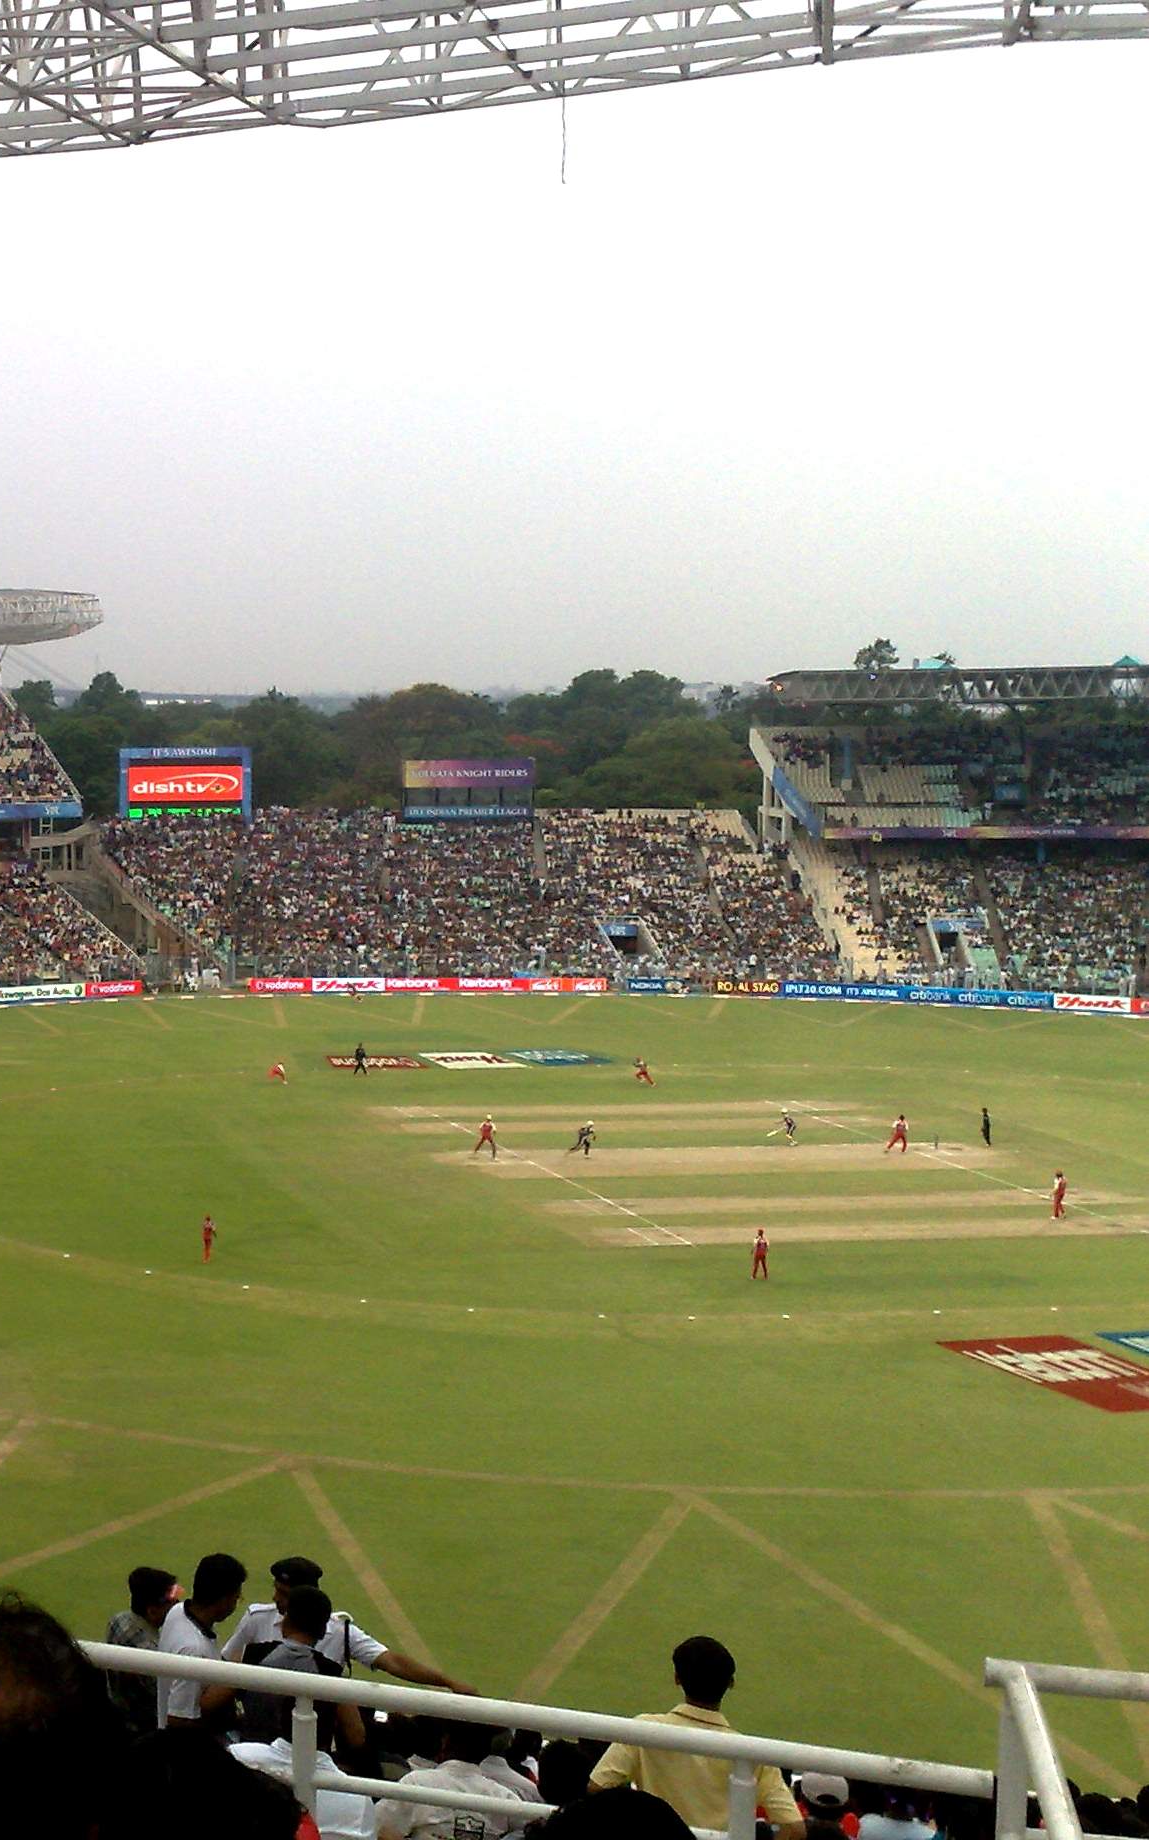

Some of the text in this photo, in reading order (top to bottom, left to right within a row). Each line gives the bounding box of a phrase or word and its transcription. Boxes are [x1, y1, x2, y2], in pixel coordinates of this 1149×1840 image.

[172, 747, 218, 756] AWESOME
[456, 770, 492, 778] KNIGHT
[265, 979, 304, 990] vodafone
[387, 978, 438, 988] Karbonn
[458, 978, 512, 988] Karbonn
[630, 982, 662, 990] NOKIA
[717, 981, 780, 993] ROAL STAG
[98, 984, 135, 995] vodafone
[909, 990, 1050, 1007] citibank citibank citibank
[1056, 994, 1130, 1009] Hunk
